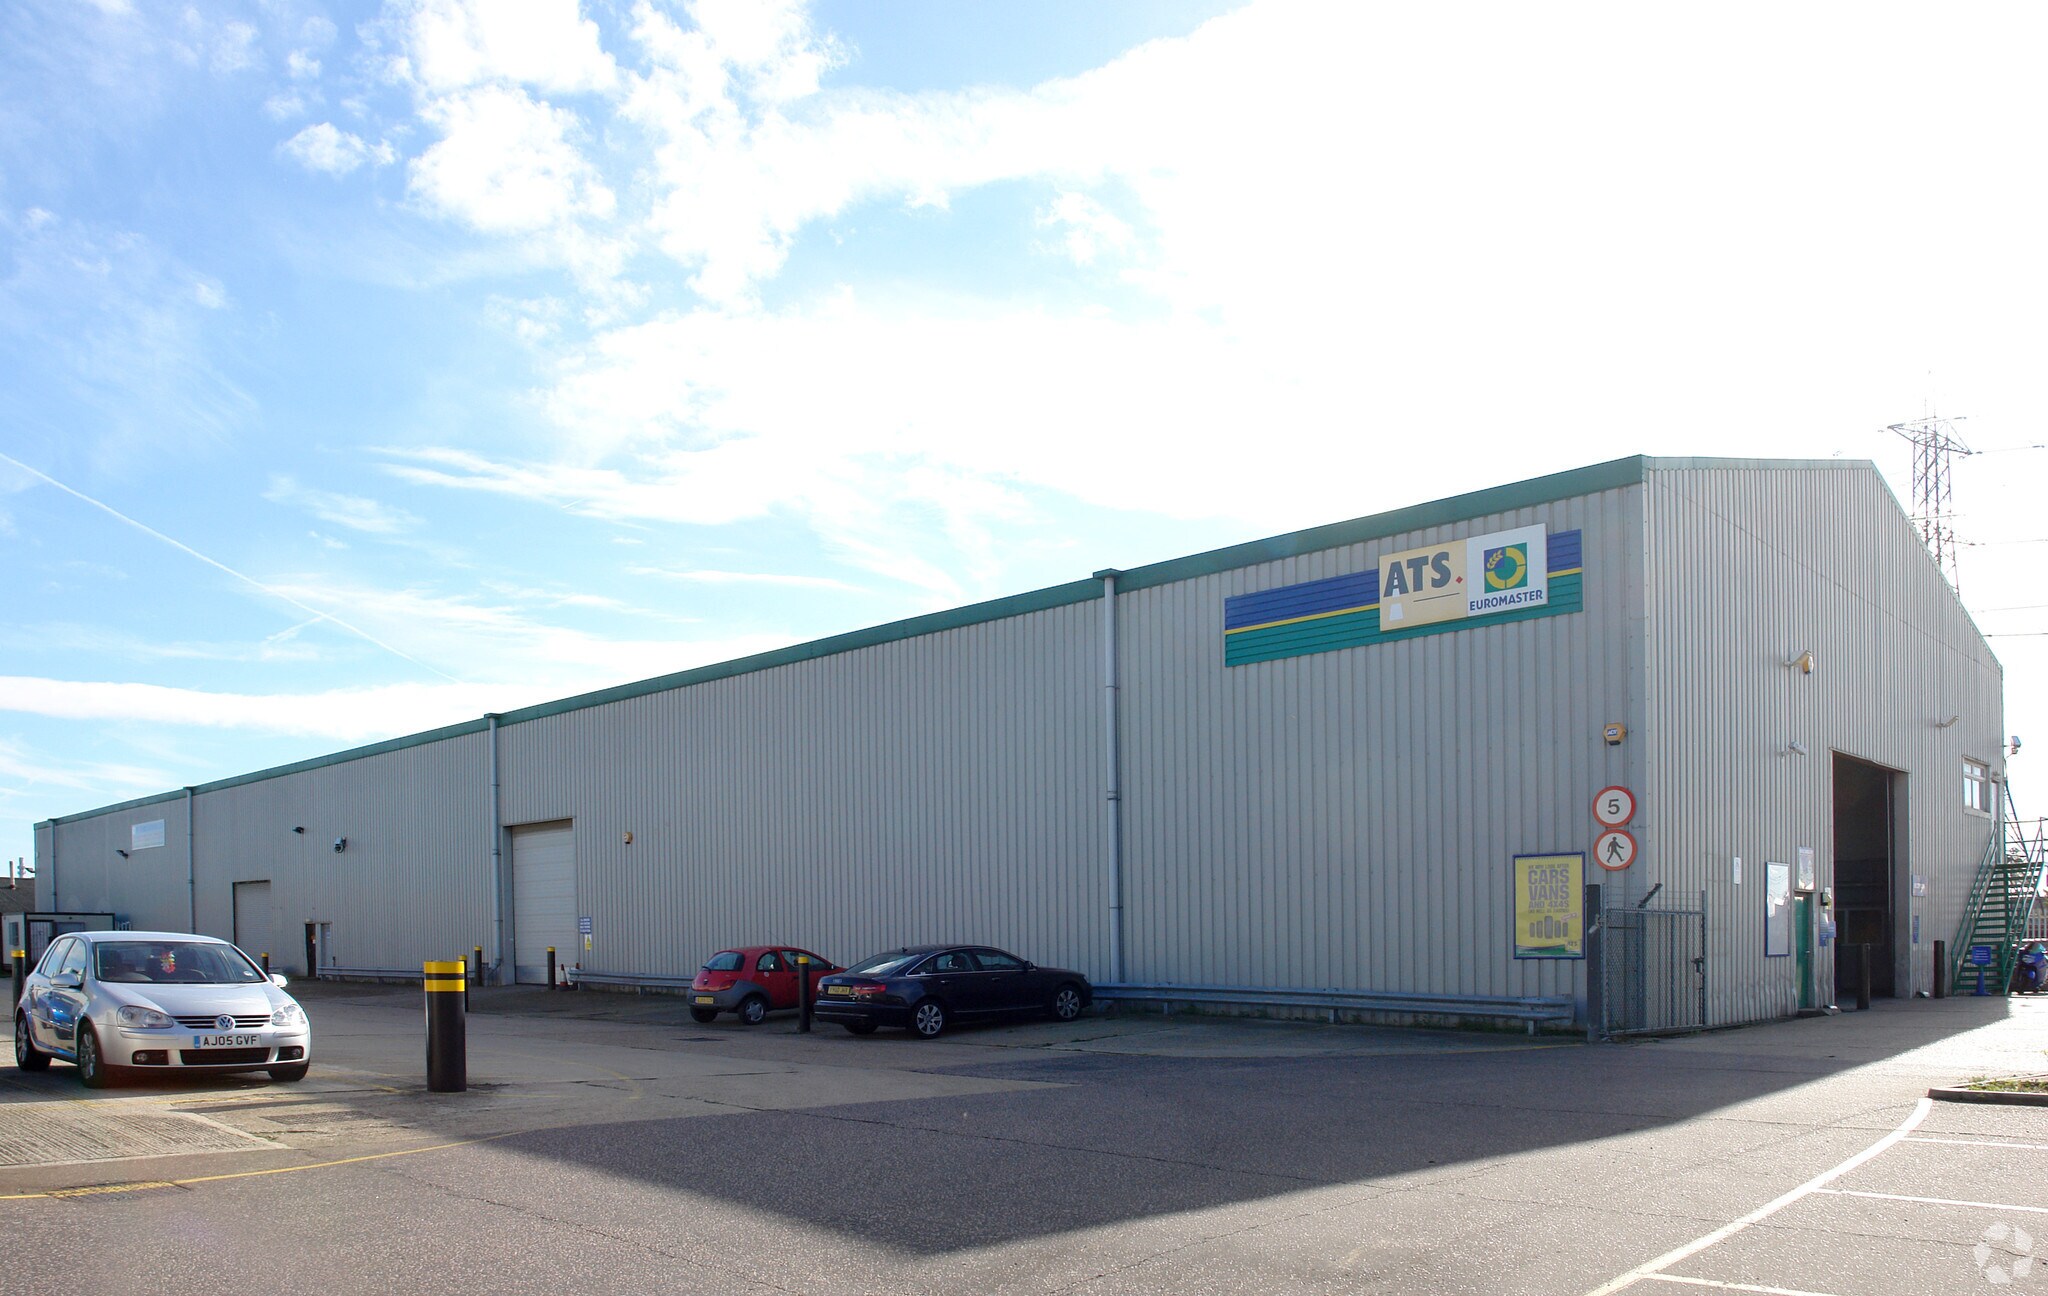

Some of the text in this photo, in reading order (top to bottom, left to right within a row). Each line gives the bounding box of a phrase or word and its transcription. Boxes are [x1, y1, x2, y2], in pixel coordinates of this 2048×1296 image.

[1383, 551, 1452, 598] ATS
[1469, 589, 1543, 611] EUROMASTER
[1607, 798, 1620, 815] 5
[1528, 869, 1569, 885] CARS
[1528, 885, 1569, 900] VANS
[1529, 900, 1545, 909] AND
[203, 1035, 257, 1046] AJ05 GVF
